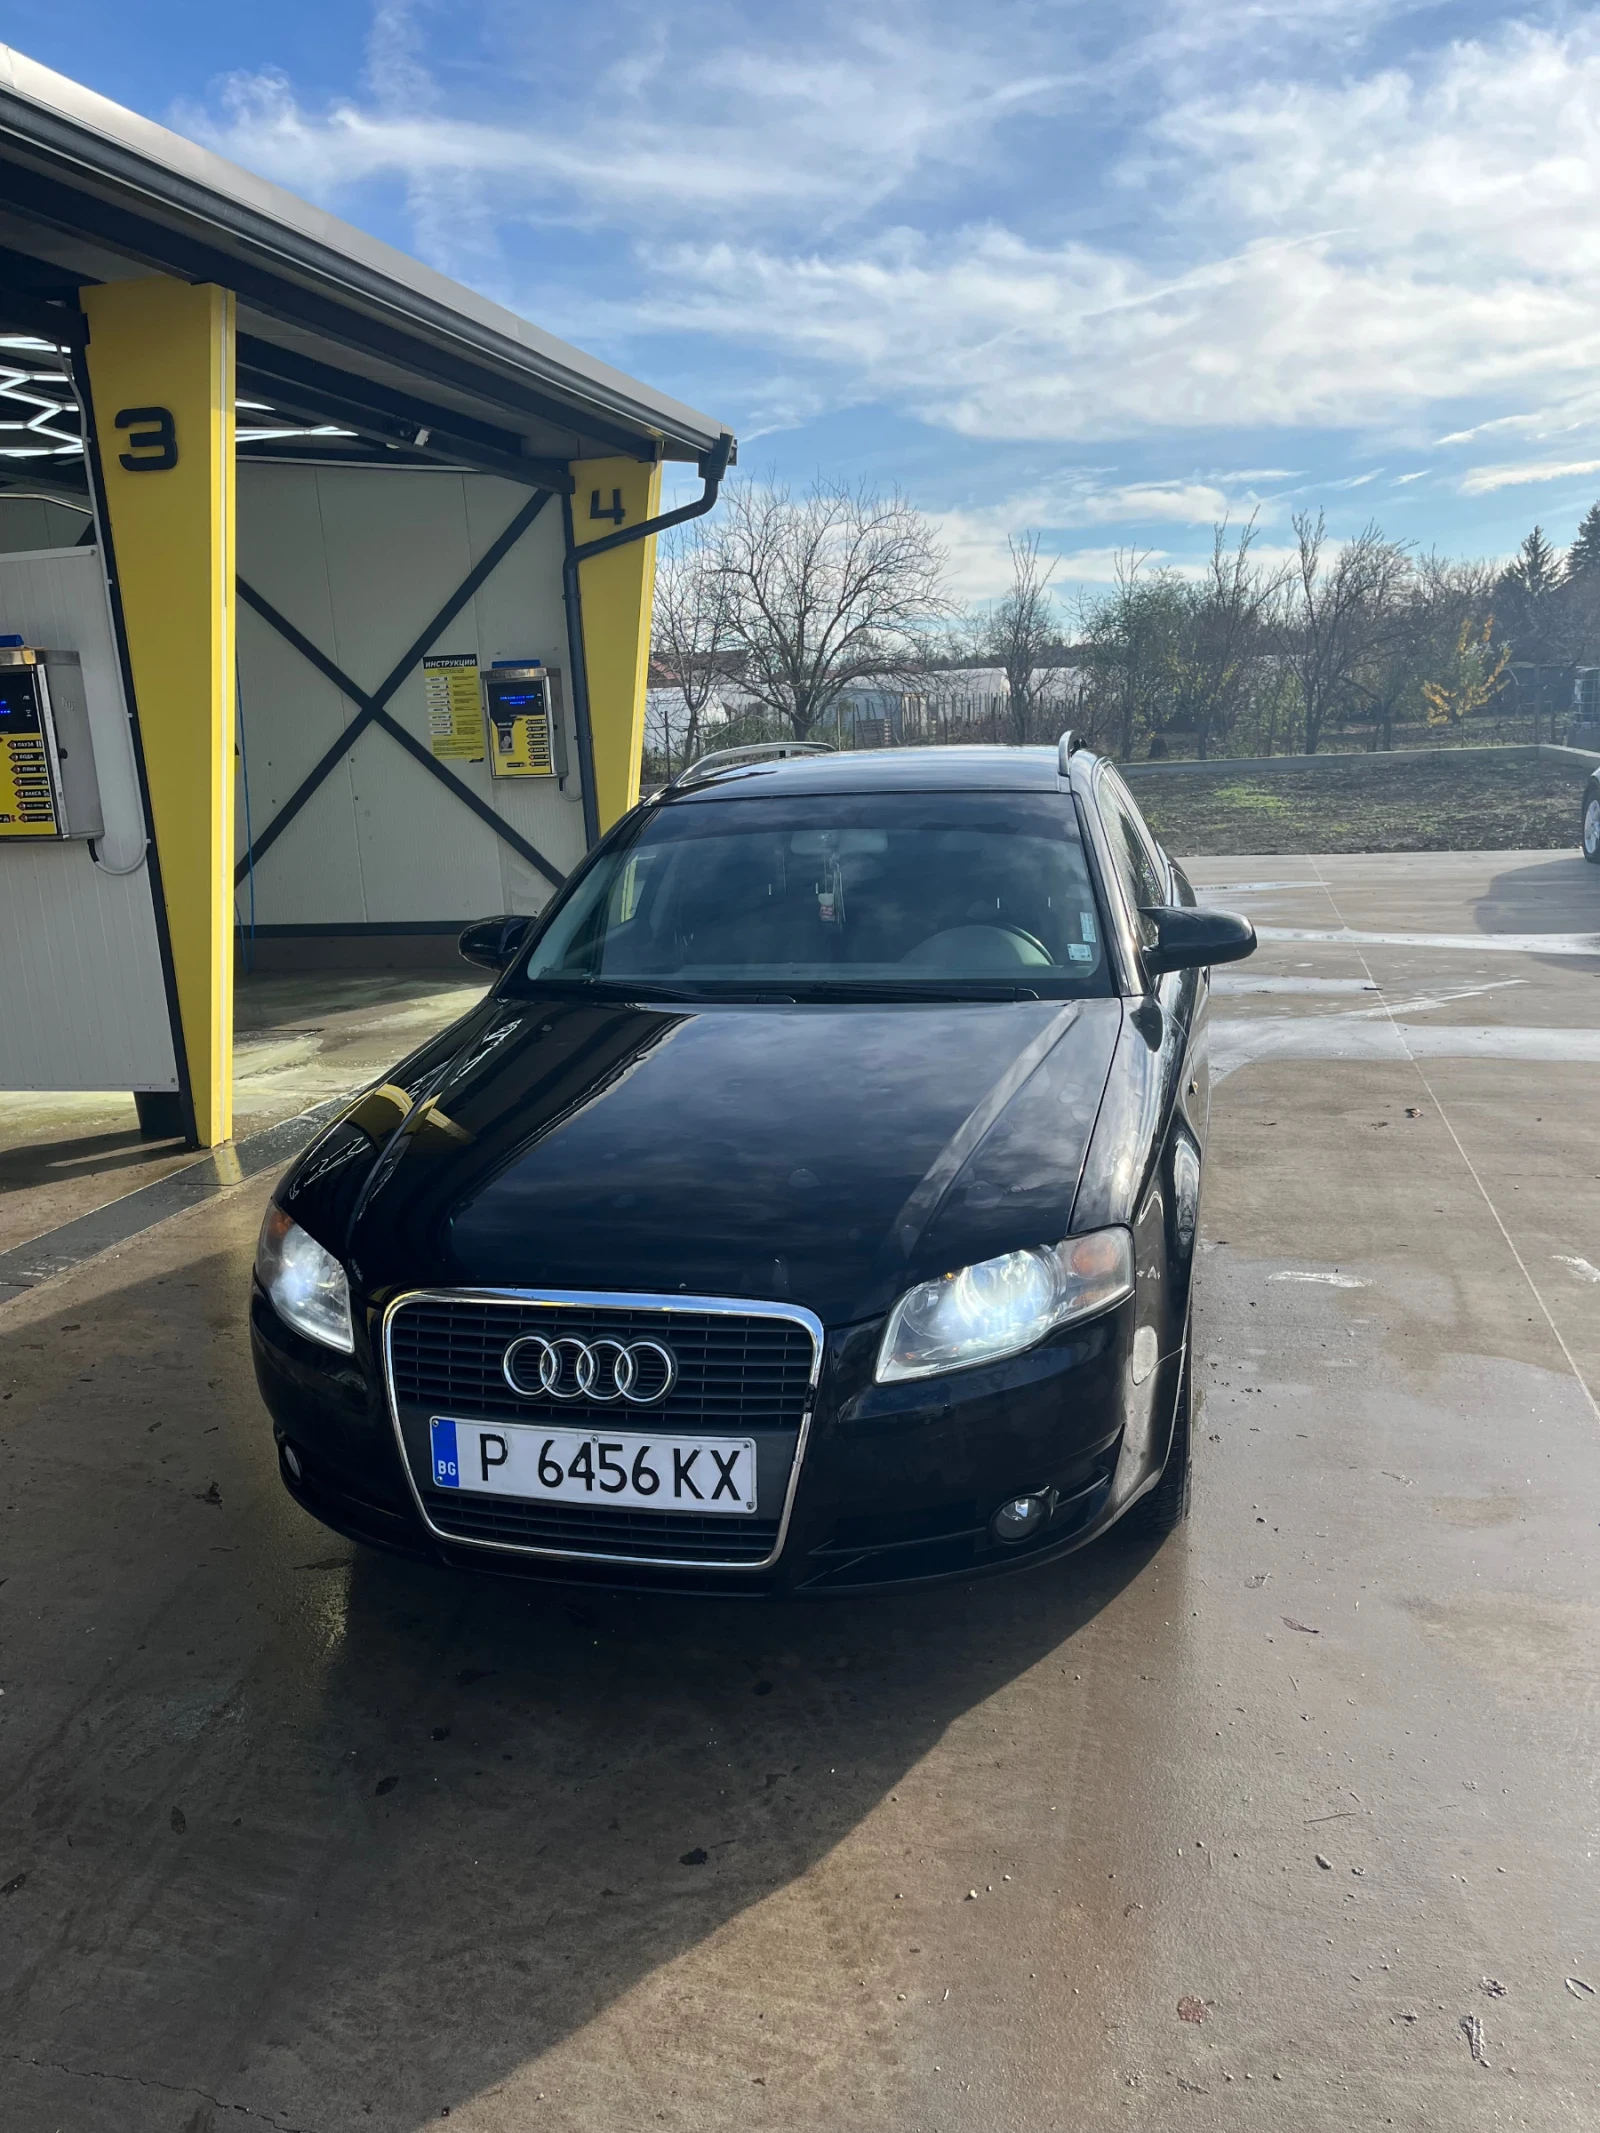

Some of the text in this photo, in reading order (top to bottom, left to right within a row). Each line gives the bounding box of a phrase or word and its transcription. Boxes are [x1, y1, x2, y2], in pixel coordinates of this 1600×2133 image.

[115, 406, 178, 472] 3
[590, 488, 625, 525] 4
[425, 658, 476, 668] ИНСТРУКЦИИ
[437, 1460, 457, 1476] BG
[479, 1433, 741, 1501] P 6456 KX
